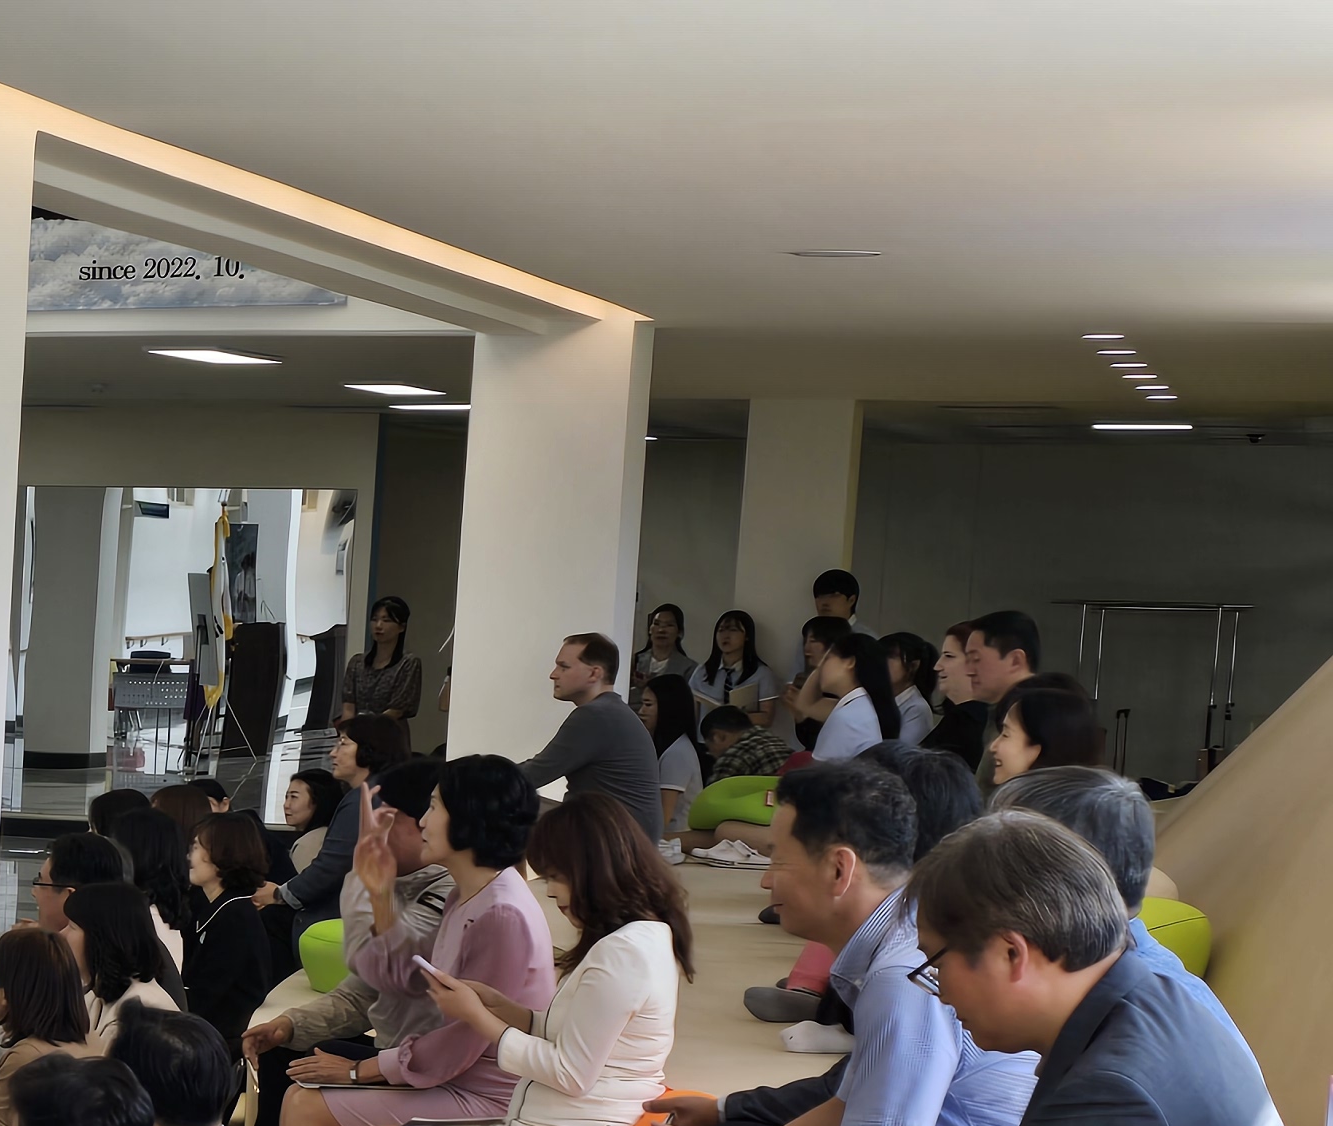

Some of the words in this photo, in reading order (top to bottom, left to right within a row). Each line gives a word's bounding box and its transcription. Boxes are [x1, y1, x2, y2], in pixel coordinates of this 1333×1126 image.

[78, 260, 136, 281] since
[143, 256, 201, 281] 2022.
[213, 256, 245, 280] 10.
